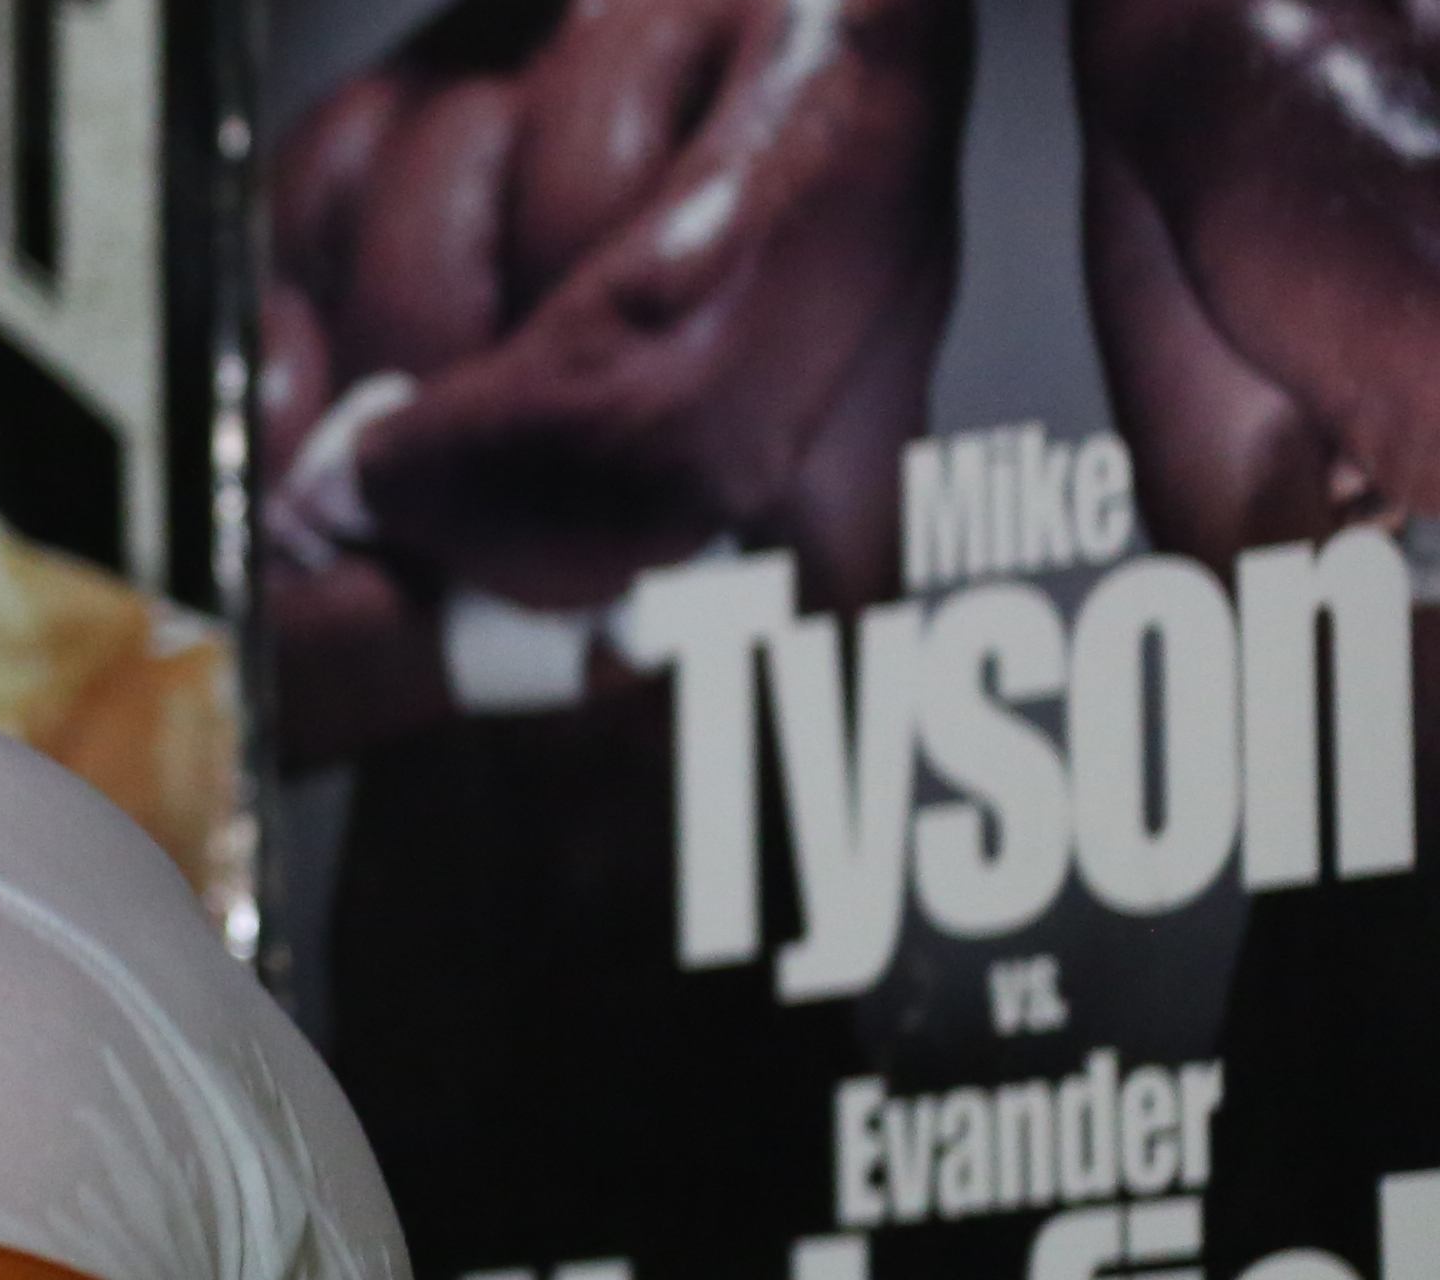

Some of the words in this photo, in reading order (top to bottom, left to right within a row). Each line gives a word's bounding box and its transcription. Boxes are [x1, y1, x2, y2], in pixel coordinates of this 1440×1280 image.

[900, 420, 1133, 590] Mike
[622, 526, 1418, 1006] Tyson
[989, 955, 1067, 1035] vs.
[835, 1048, 1223, 1228] Evander
